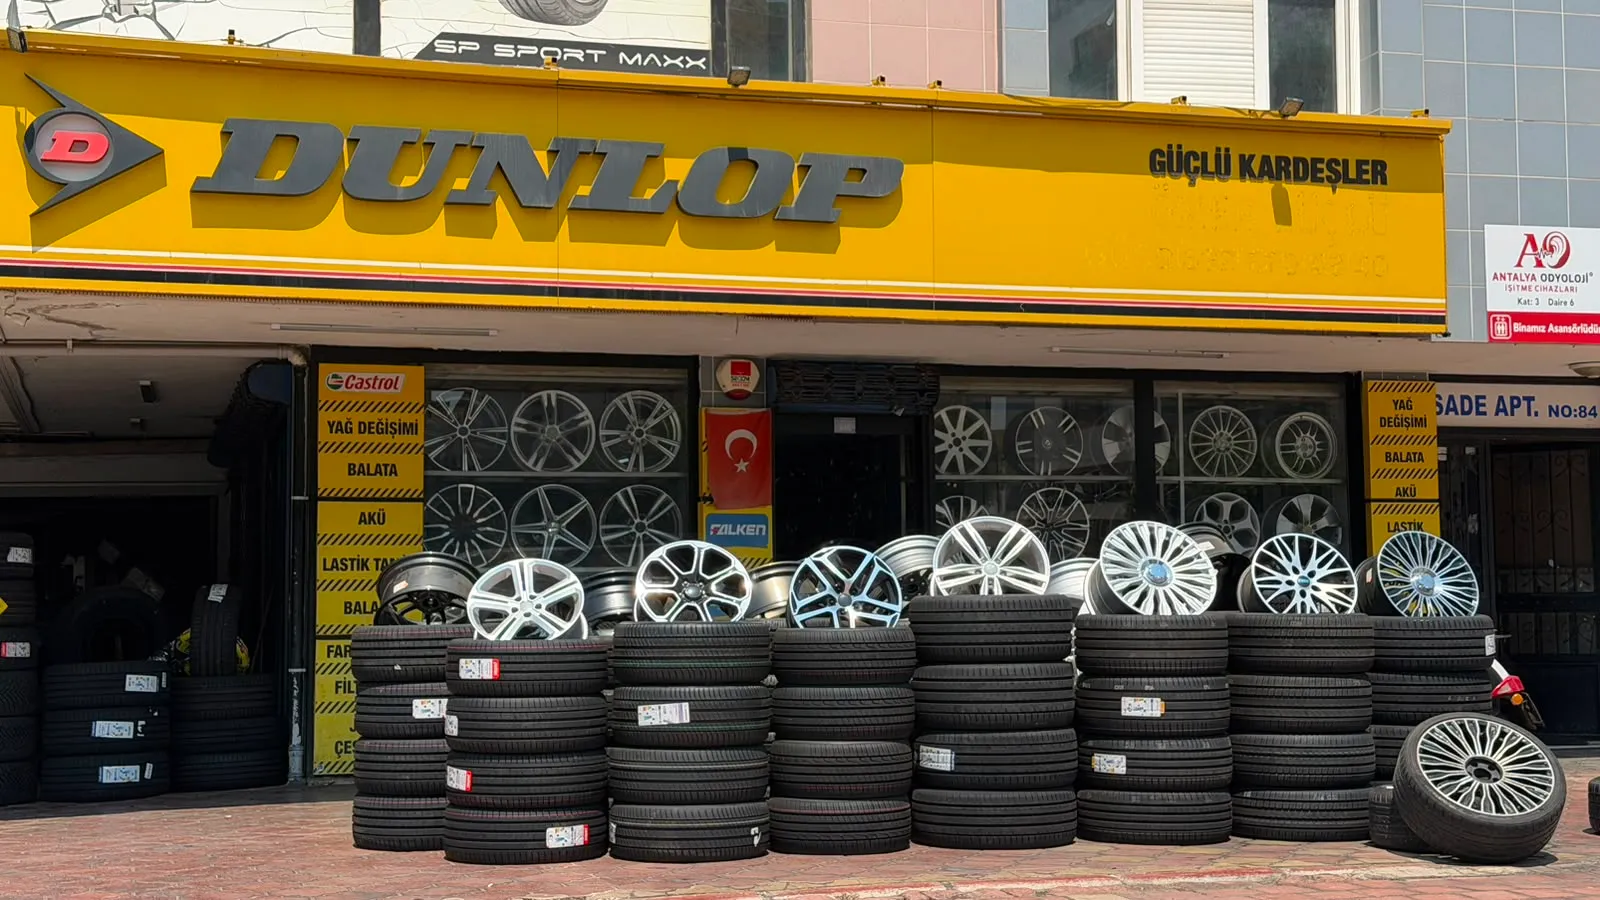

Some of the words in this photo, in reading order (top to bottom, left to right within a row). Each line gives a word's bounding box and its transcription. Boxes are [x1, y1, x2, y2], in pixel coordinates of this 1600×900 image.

[434, 39, 480, 54] SP
[493, 43, 606, 63] SPORT
[618, 51, 706, 69] MAXX
[190, 117, 904, 223] DUNLOP
[1149, 143, 1231, 188] GÜÇLÜ
[1238, 153, 1388, 195] KARDEŞLER
[1492, 272, 1537, 282] ANTALYA
[1517, 297, 1533, 306] Kat:
[1535, 298, 1540, 306] 3
[1548, 298, 1568, 306] Daire
[1513, 322, 1546, 333] Binamız
[344, 374, 401, 391] Castrol
[1392, 397, 1413, 411] YAĞ
[1494, 395, 1539, 417] APT.
[1548, 405, 1598, 418] NO:84
[327, 418, 354, 434] YAĞ
[358, 418, 419, 439] DEĞİŞİMİ
[1379, 415, 1427, 431] DEĞİŞİMİ
[1385, 451, 1424, 463] BALATA
[347, 462, 399, 477] BALATA
[1395, 484, 1417, 498] AKÜ
[358, 508, 386, 526] AKÜ
[710, 524, 766, 536] FALKEN
[1387, 519, 1424, 533] LASTİK
[322, 554, 370, 572] LASTİK
